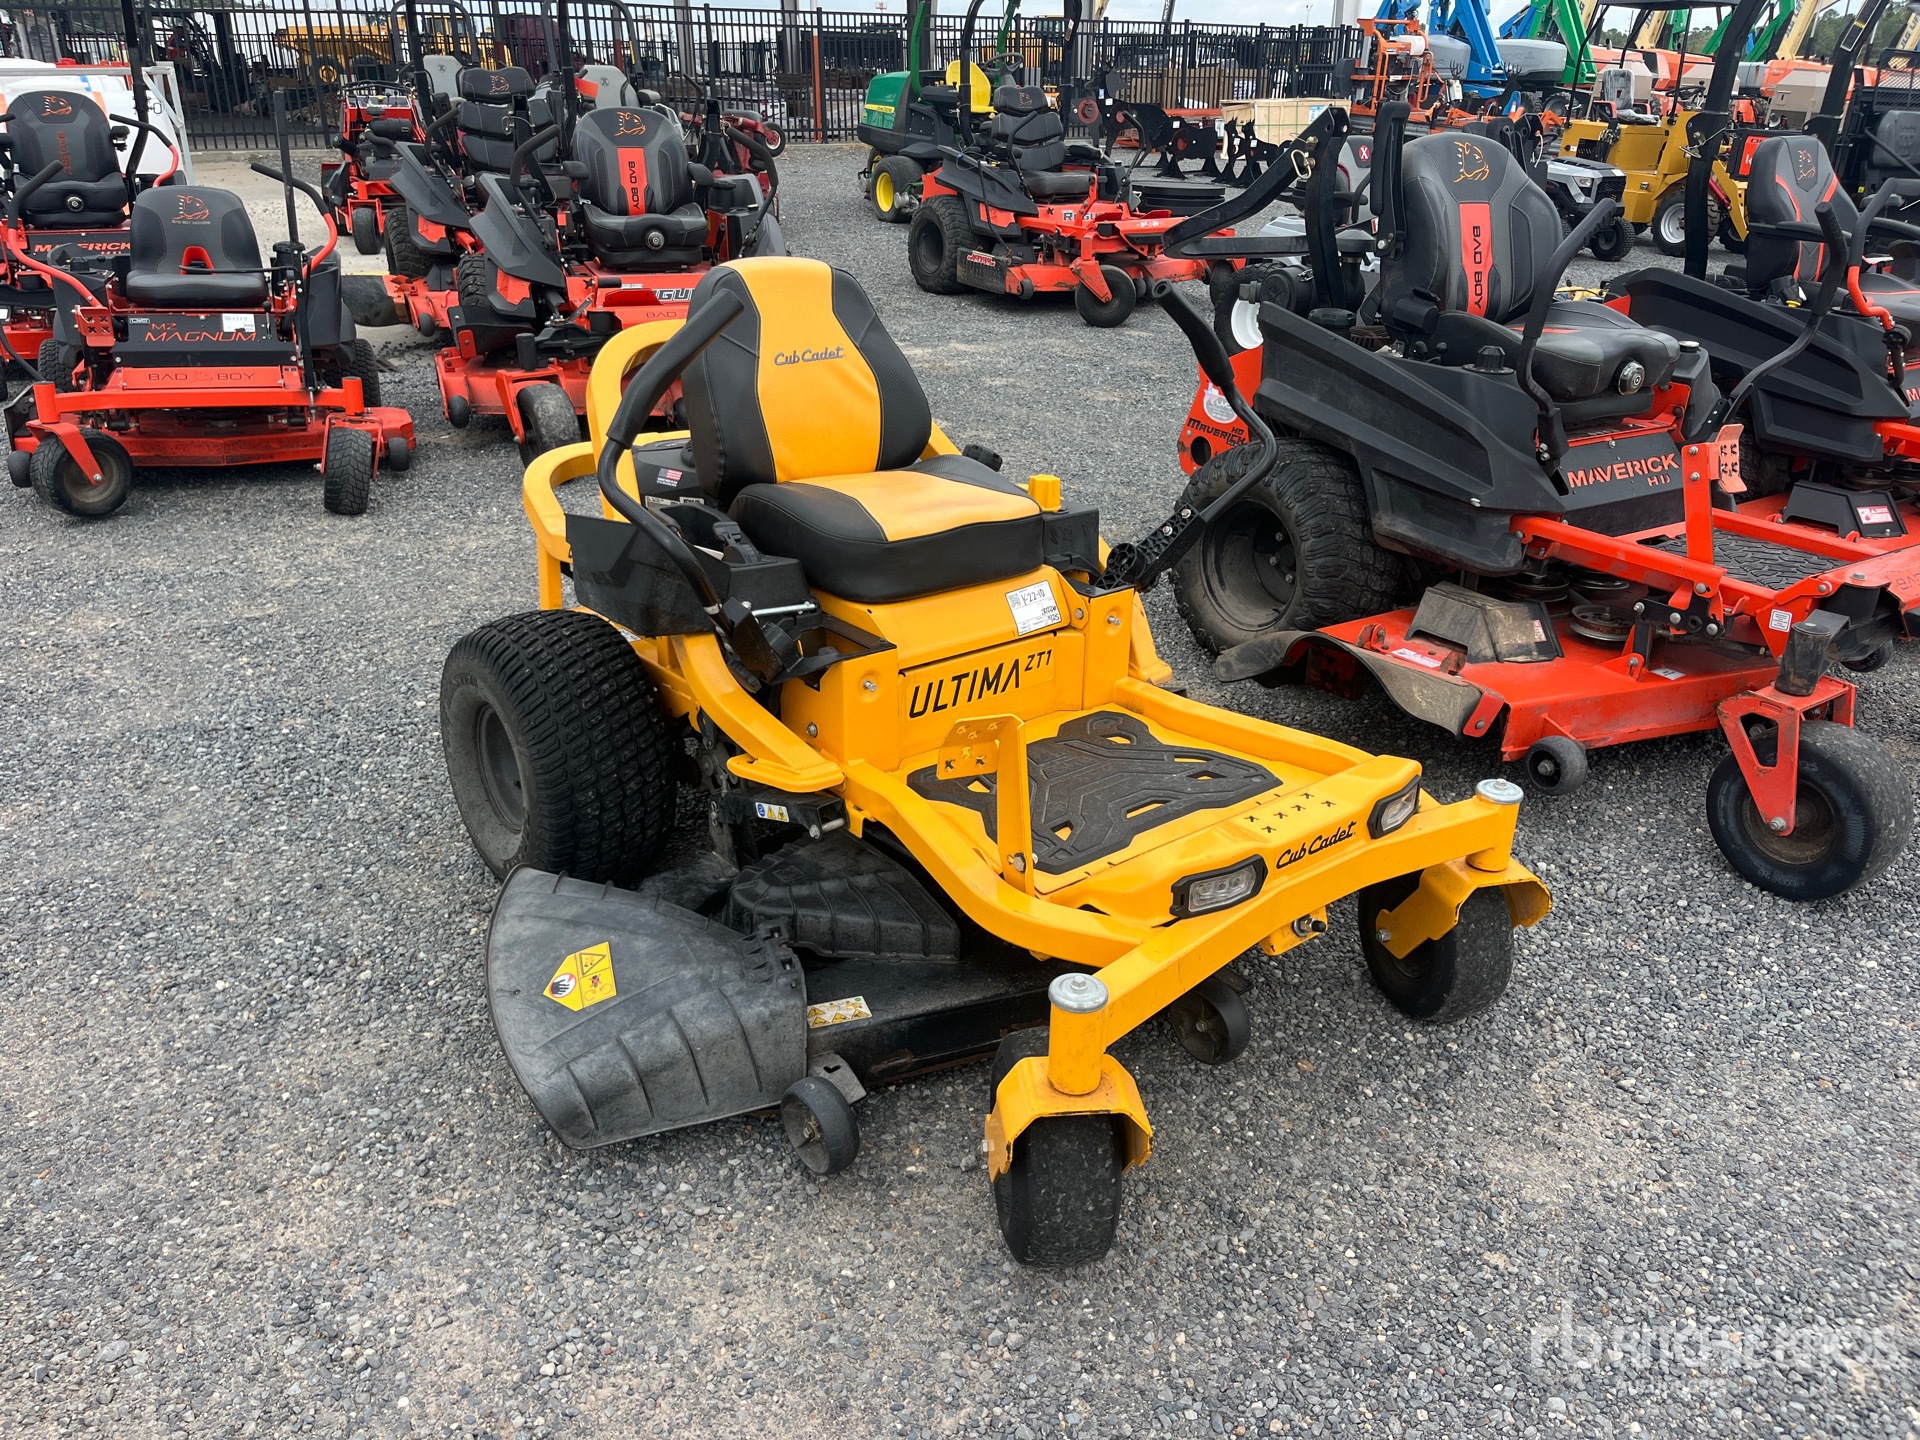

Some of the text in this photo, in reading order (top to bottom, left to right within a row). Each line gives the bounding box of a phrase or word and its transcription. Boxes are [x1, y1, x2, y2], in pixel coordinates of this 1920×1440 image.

[1900, 31, 1912, 50] JLG
[628, 160, 641, 211] BAD BOY
[1472, 225, 1484, 309] BAD BOY
[151, 322, 177, 330] MZ
[144, 331, 257, 342] MAGNUM
[774, 346, 844, 366] Cub Cadet
[148, 372, 257, 381] BAD BOY
[1186, 418, 1247, 447] MAVERICK
[1231, 427, 1245, 436] HD
[1567, 453, 1680, 488] MAVERICK
[1647, 473, 1672, 487] HD
[908, 648, 1052, 719] ULTIMA ZT1
[1276, 820, 1357, 869] Cub Cadet
